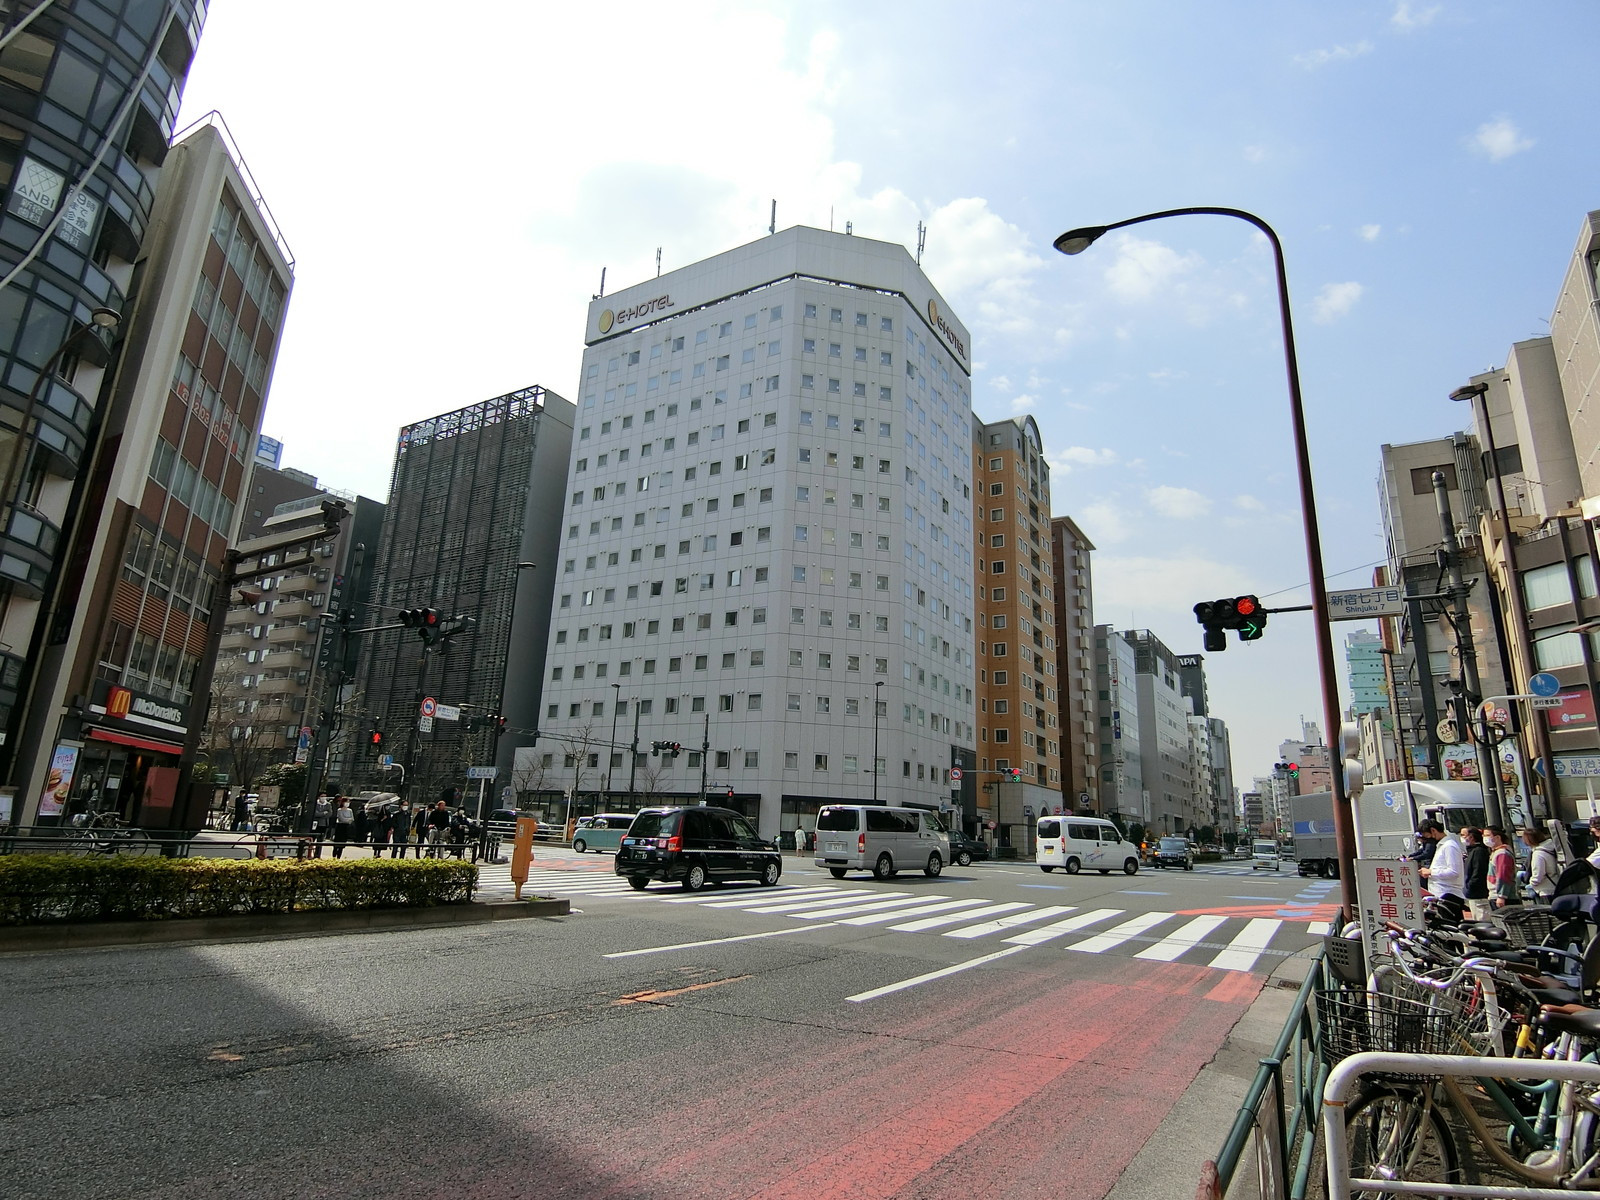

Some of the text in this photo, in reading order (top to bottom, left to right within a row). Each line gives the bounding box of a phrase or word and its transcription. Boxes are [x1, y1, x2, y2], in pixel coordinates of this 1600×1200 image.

[1330, 590, 1399, 606] 新宿七丁目
[1345, 604, 1378, 613] Shinjuku
[132, 697, 182, 722] McDonald's
[1553, 763, 1565, 772] 05
[1570, 759, 1600, 769] 明治
[1399, 866, 1416, 921] 赤い部分は
[1375, 867, 1400, 955] 駐停車止
